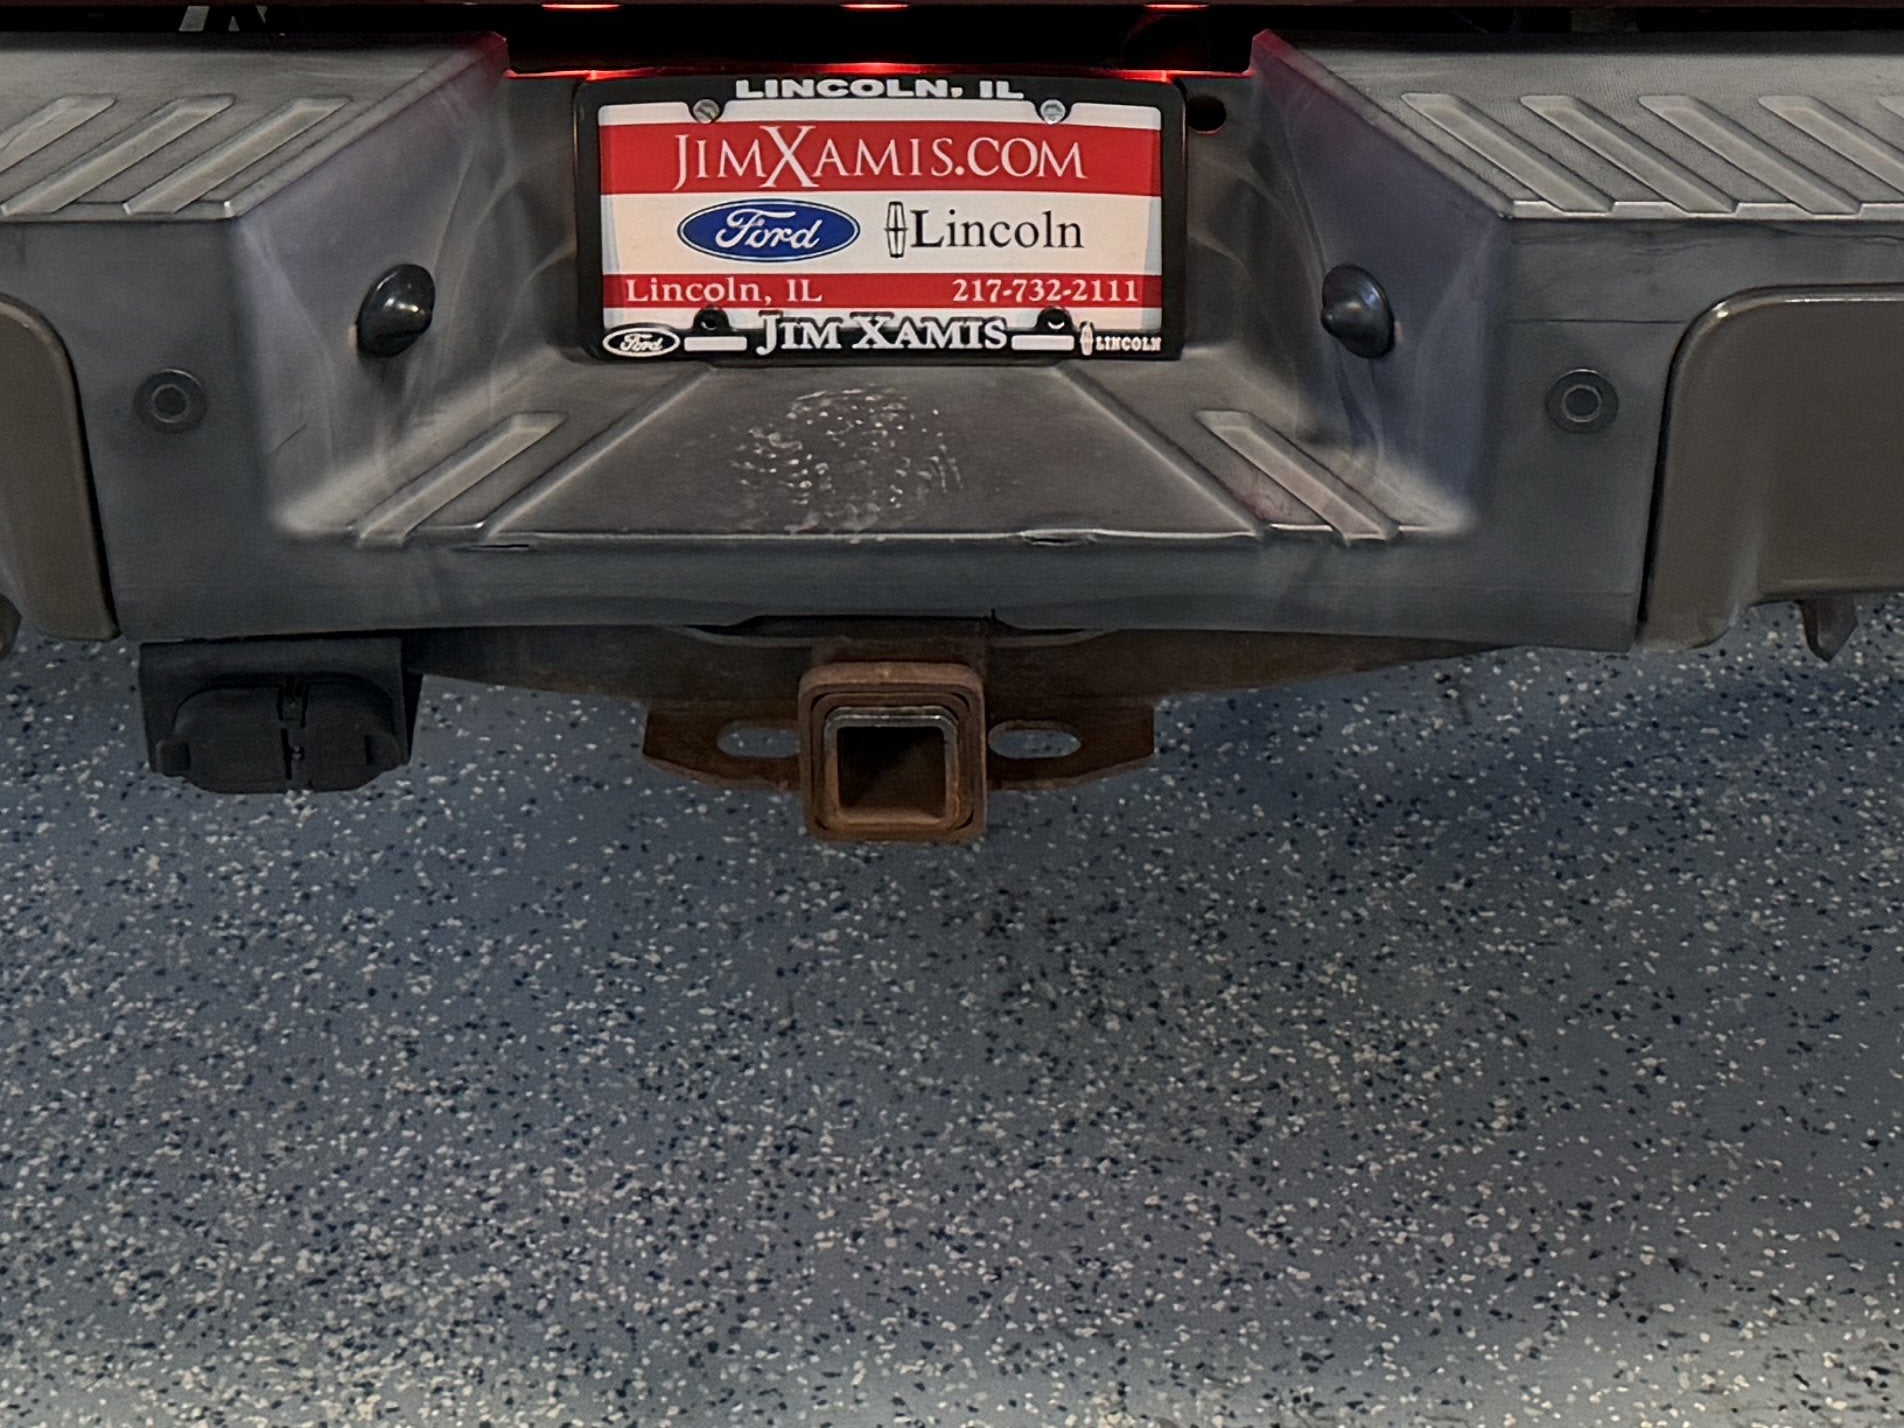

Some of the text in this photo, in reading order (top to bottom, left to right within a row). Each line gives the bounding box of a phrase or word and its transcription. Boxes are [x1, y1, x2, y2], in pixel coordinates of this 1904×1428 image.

[979, 80, 1025, 100] IL
[673, 125, 1088, 191] JIMXAMIS.COM
[715, 210, 823, 250] Ford
[910, 208, 1084, 249] Lincoln
[626, 276, 823, 305] Lincoln, IL
[952, 278, 1138, 303] 217-732-2111
[619, 333, 663, 352] Ford
[756, 311, 1008, 356] JIM XAMIS
[1096, 336, 1162, 351] LINCOLN
